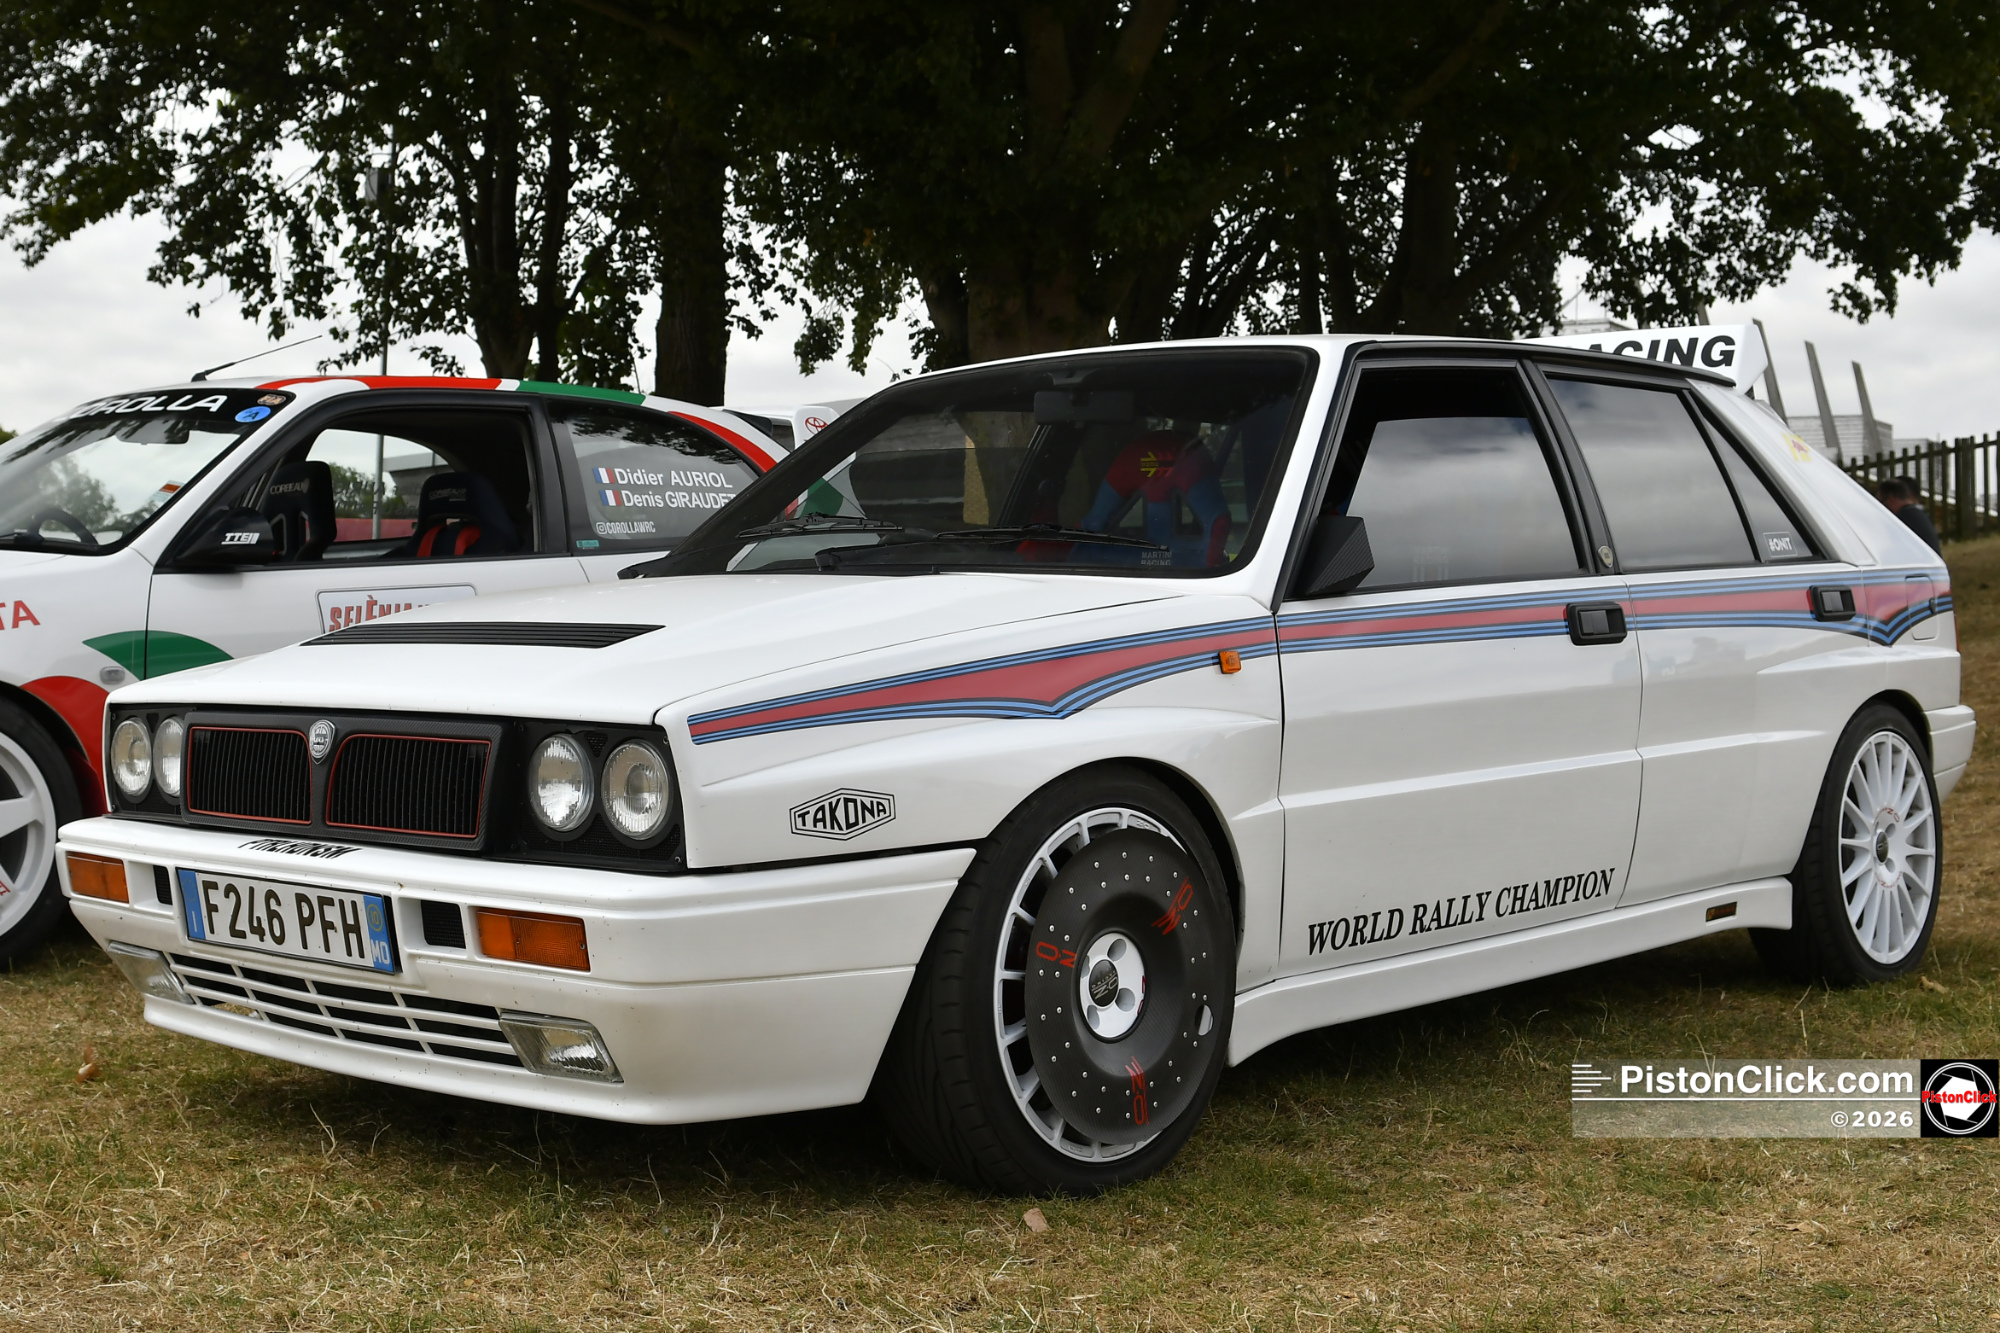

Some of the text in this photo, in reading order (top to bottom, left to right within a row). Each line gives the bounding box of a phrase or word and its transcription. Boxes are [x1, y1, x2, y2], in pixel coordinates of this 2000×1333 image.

[615, 468, 733, 489] Didier AURIOL
[622, 490, 664, 508] Denis
[606, 521, 656, 534] COROLLAWRC
[1141, 551, 1172, 559] MARTINI
[797, 797, 887, 831] TAKONA
[202, 880, 285, 946] F246
[295, 892, 365, 959] PFH
[1308, 867, 1615, 956] WORLD RALLY CHAMPION
[370, 939, 391, 965] MO
